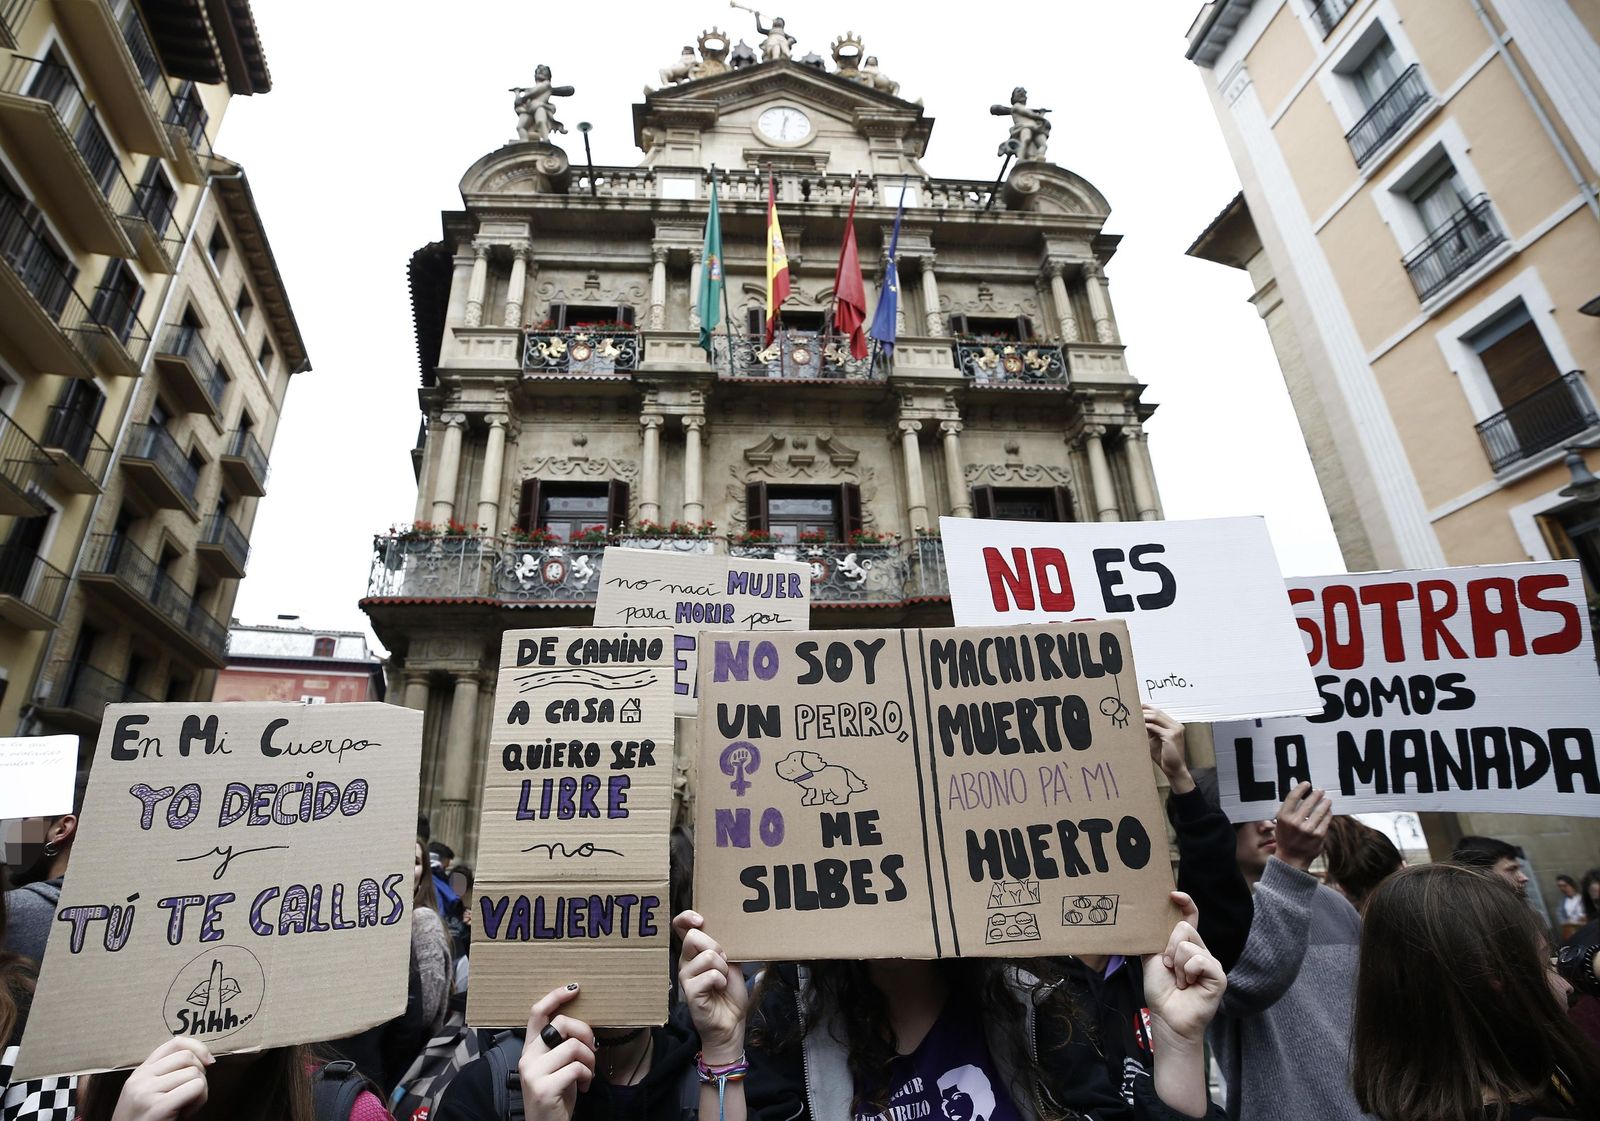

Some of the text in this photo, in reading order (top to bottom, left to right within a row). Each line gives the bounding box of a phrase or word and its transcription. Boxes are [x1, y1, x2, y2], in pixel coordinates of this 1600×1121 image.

[605, 577, 661, 591] no
[727, 570, 803, 599] MUJER
[982, 543, 1177, 613] NO ES
[617, 602, 793, 630] para MORIR por
[1287, 574, 1582, 670] SOTRAS
[516, 637, 559, 667] DE
[712, 640, 780, 683] NO
[794, 638, 886, 685] SOY
[929, 632, 1123, 690] MACHIRULO
[1145, 672, 1194, 700] punto.
[1304, 673, 1476, 724] SOMOS
[507, 698, 615, 725] A CASA
[716, 700, 908, 743] UN PERRO,
[937, 695, 1093, 758] MUERTO
[111, 714, 382, 763] En Mi Cuerpo
[610, 739, 656, 769] SER
[948, 767, 1027, 810] ABONO
[1082, 761, 1120, 800] MI
[1234, 727, 1600, 802] LA MANADA
[129, 783, 201, 830] YO
[515, 774, 631, 821] LIBRE
[521, 842, 624, 860] no
[714, 807, 883, 849] NO ME
[965, 816, 1151, 883] HUERTO
[740, 854, 907, 913] SILBES
[58, 874, 404, 954] TÚ TE CALLAS
[479, 894, 660, 941] VALIENTE
[891, 1076, 924, 1101] GUR
